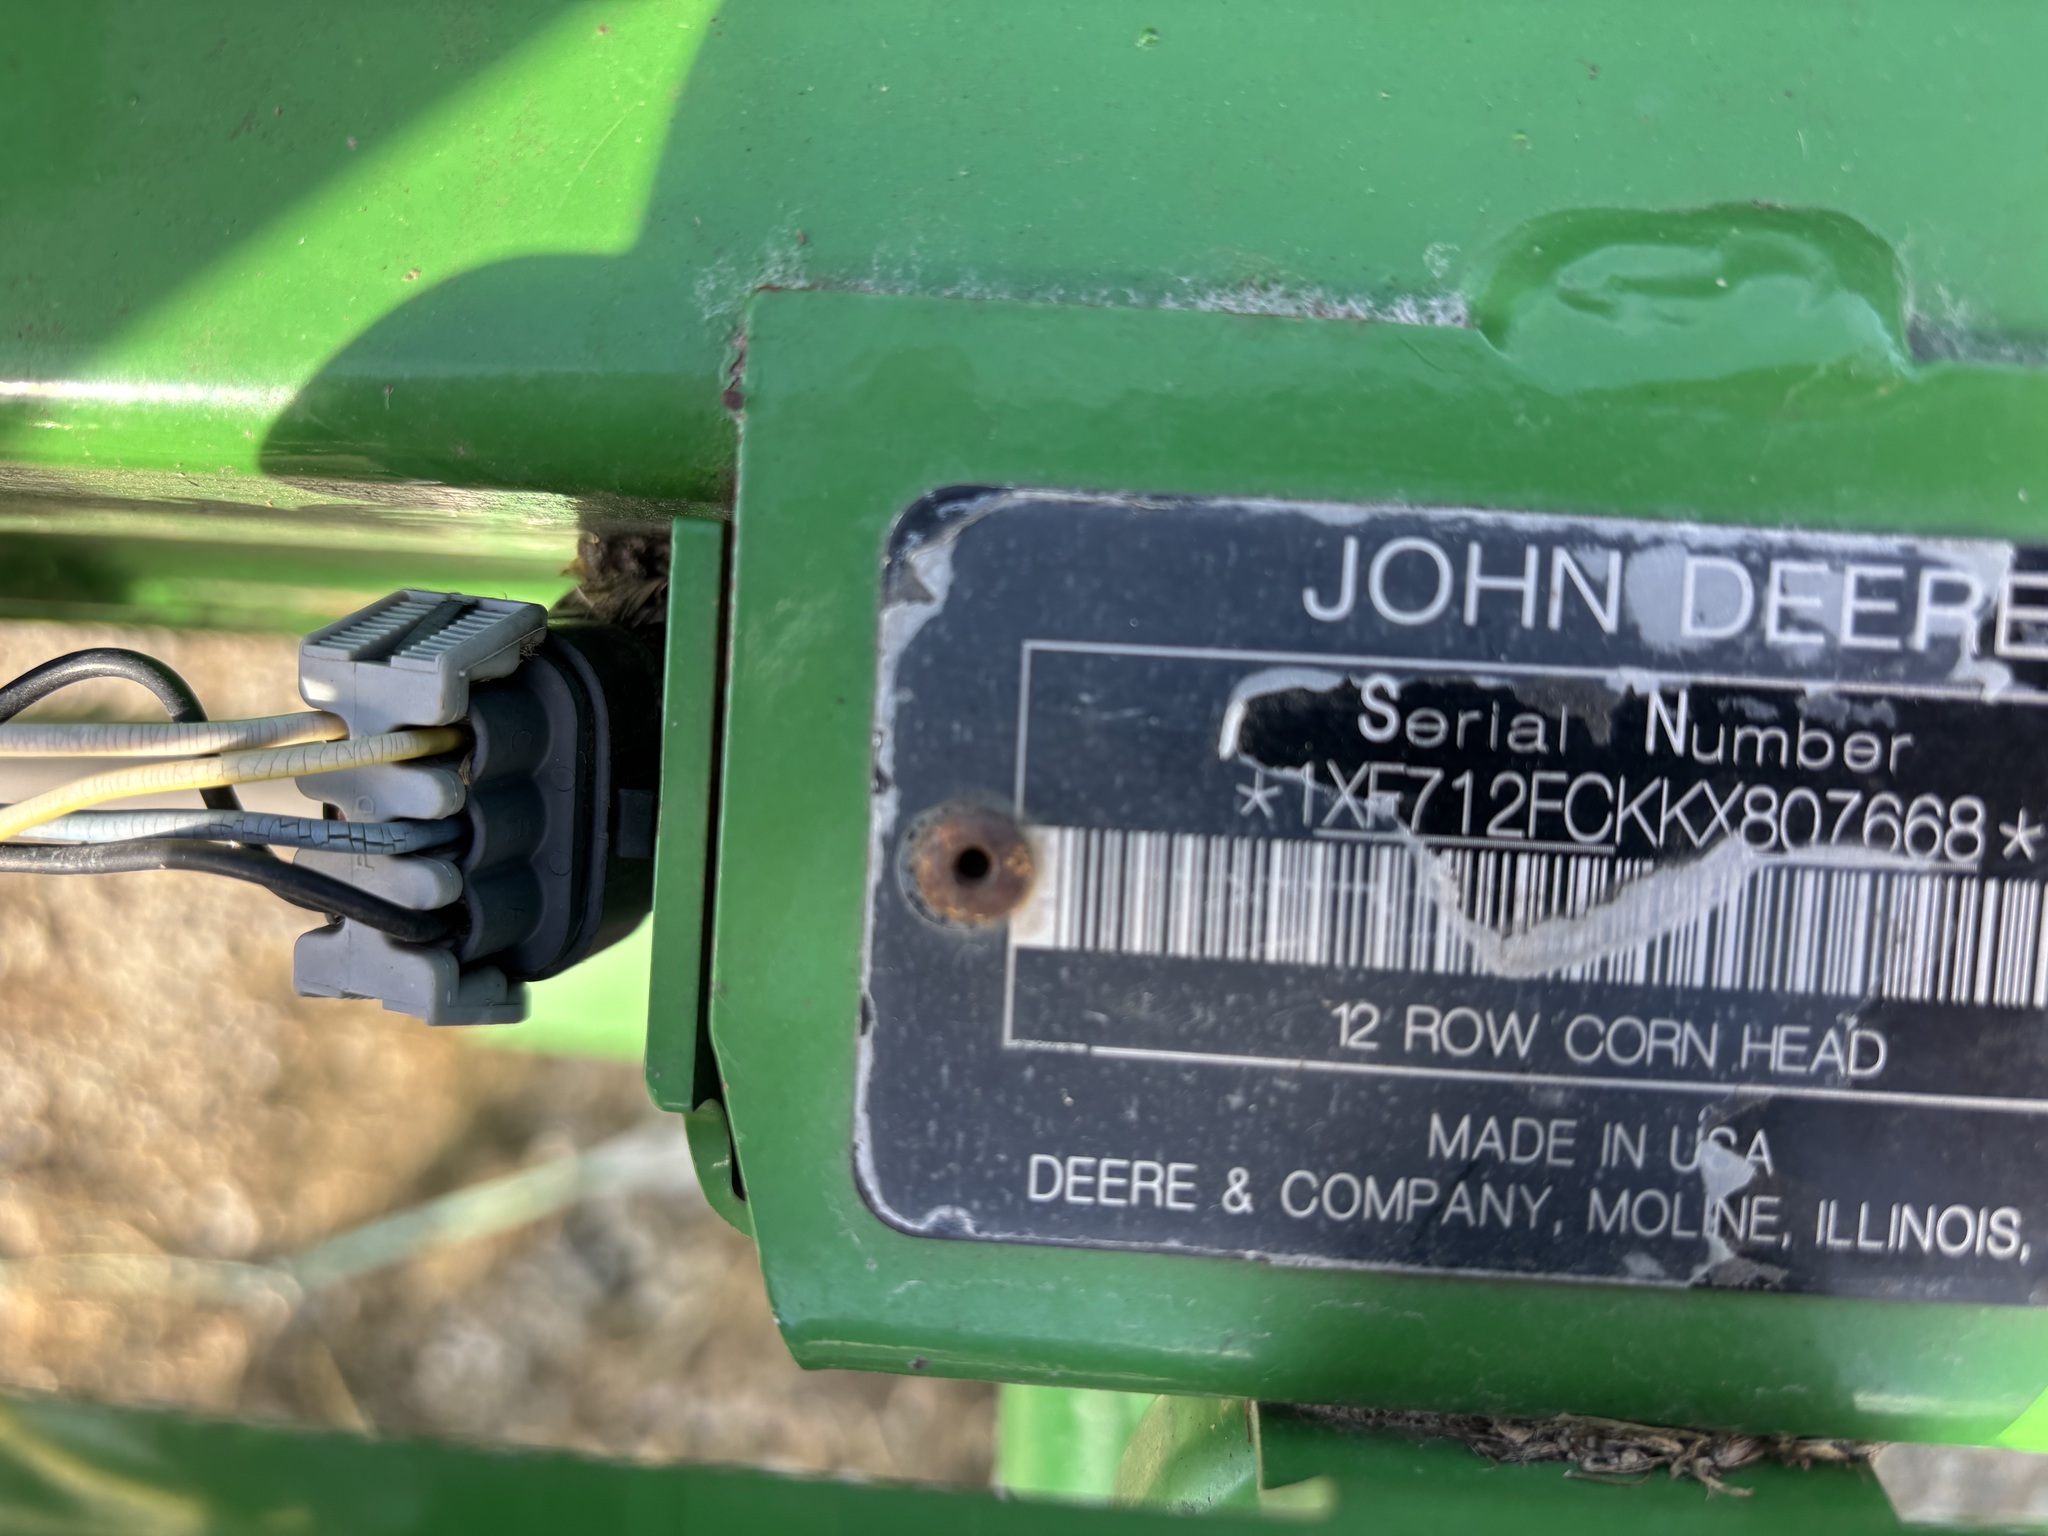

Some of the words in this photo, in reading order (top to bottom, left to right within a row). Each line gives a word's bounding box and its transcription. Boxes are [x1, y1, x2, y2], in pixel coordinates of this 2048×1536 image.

[1302, 535, 1623, 634] JOHN
[1680, 554, 2048, 658] DEERE
[1357, 673, 1568, 755] Serial
[1644, 688, 1914, 774] Number
[1331, 1001, 1381, 1051] 12
[1404, 1004, 1540, 1059] ROW
[1564, 1013, 1719, 1069] CORN
[1740, 1022, 1888, 1079] HEAD
[1427, 1112, 1578, 1167] MADE
[1601, 1121, 1647, 1171] IN
[1027, 1153, 1198, 1211] DEERE
[1221, 1166, 1254, 1215] &
[1280, 1168, 1563, 1237] COMPANY,
[1587, 1186, 1792, 1250] MOLINE,
[1815, 1198, 2032, 1266] ILLINOIS,
